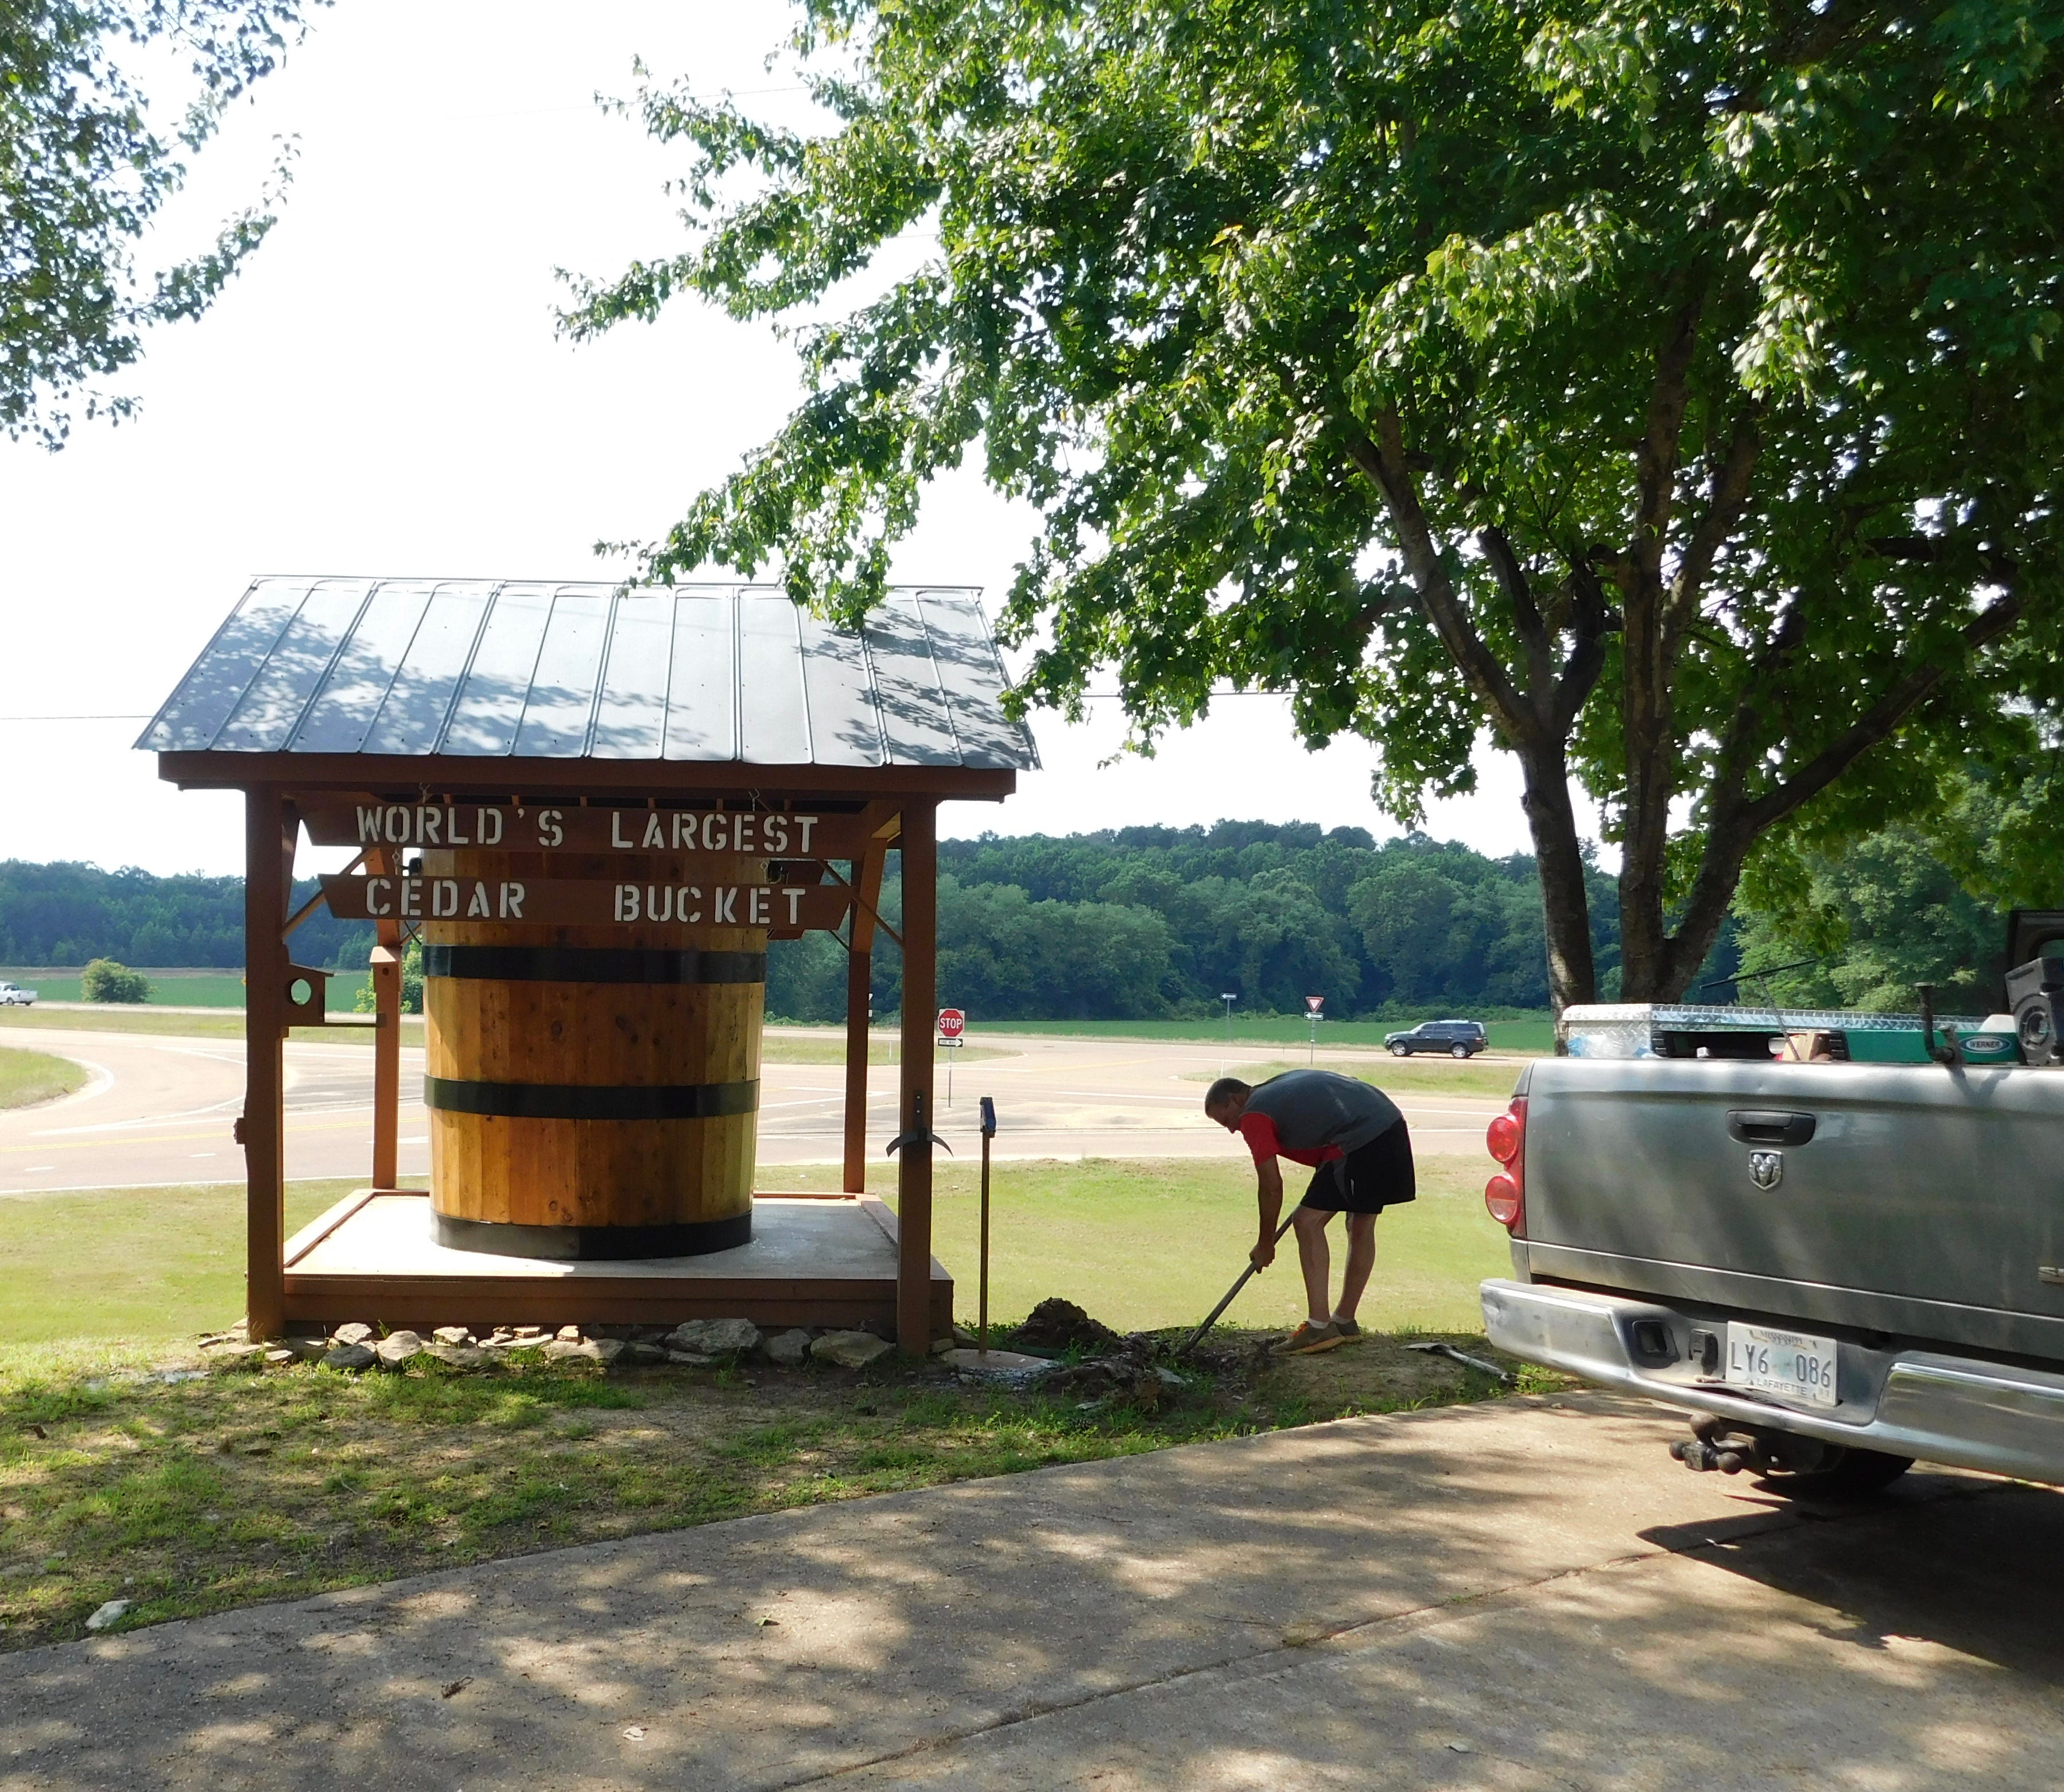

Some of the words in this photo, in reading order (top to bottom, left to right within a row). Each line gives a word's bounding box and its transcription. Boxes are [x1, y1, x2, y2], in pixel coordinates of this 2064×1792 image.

[357, 806, 563, 846] WORLD'S
[612, 812, 818, 853] LARGEST
[366, 878, 525, 918] CEDAR
[614, 885, 806, 924] BUCKET
[940, 1018, 962, 1029] STOP
[1731, 1341, 1768, 1374] LY6
[1796, 1354, 1831, 1387] 086
[1757, 1378, 1807, 1395] LAFAYETTE
